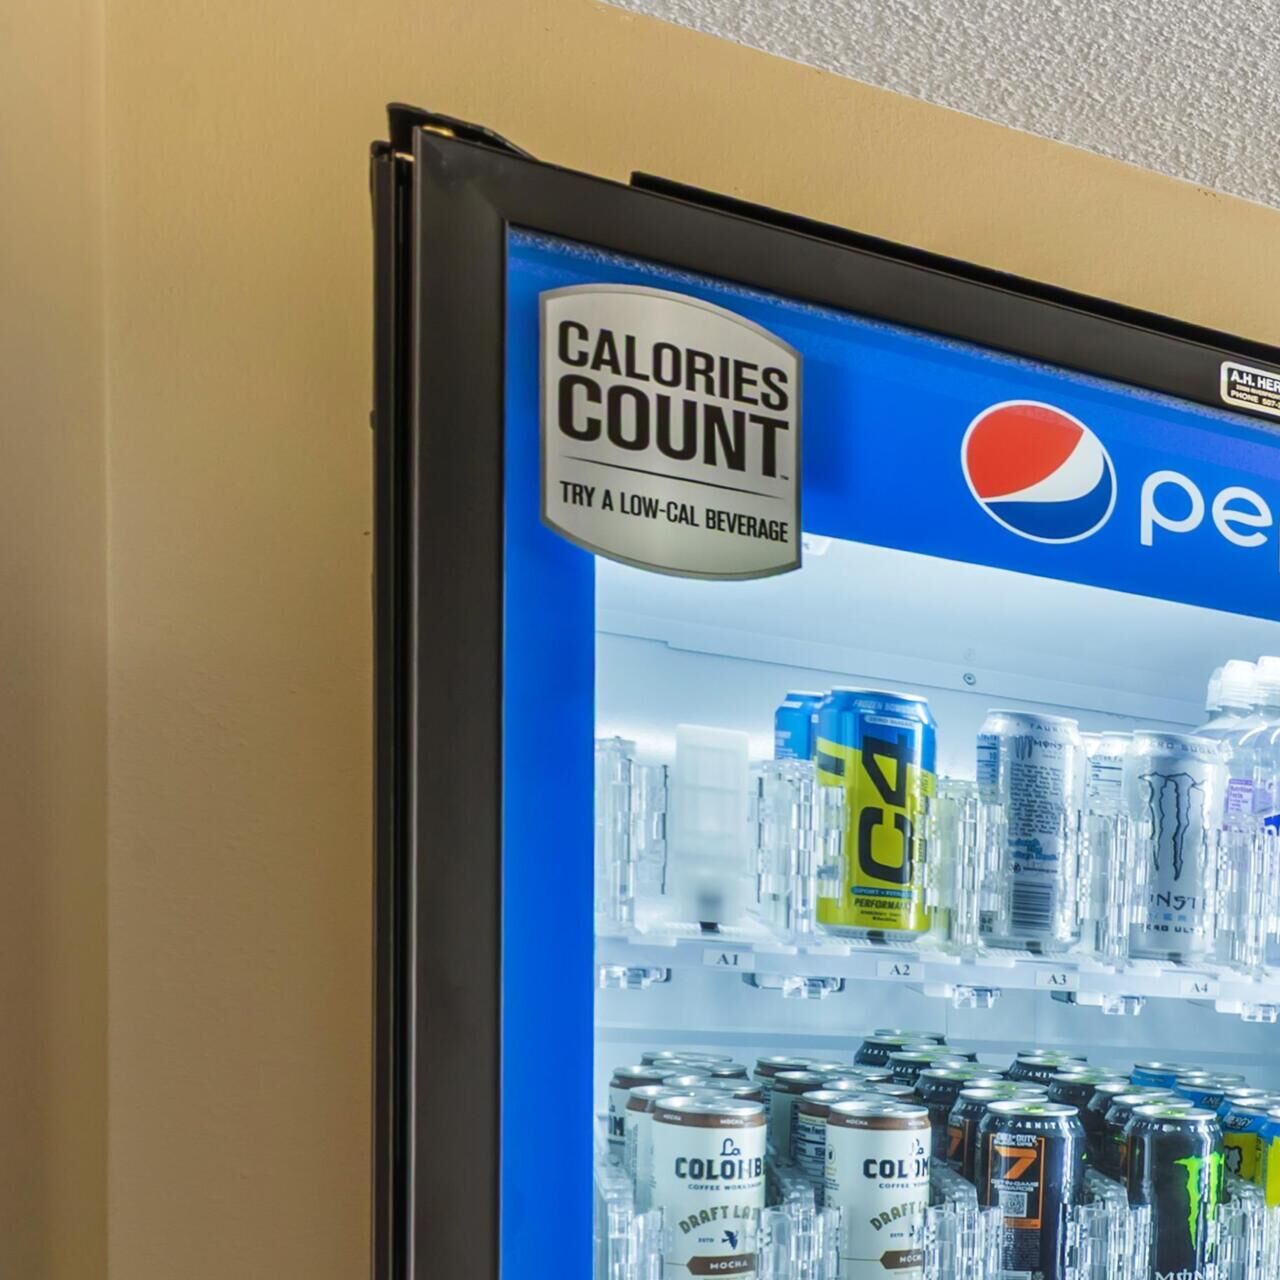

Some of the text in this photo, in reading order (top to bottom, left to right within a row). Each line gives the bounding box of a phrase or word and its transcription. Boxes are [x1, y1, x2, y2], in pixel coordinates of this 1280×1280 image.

[558, 320, 789, 412] CALORIES
[1230, 370, 1255, 387] A.H.
[1230, 389, 1259, 404] PHONE
[558, 374, 789, 479] COUNT
[560, 481, 788, 543] TRY A LOW-CAL BEVERAGE
[716, 953, 739, 966] A1
[889, 963, 911, 976] A2
[1049, 973, 1067, 986] A3
[1191, 983, 1208, 993] A4
[719, 1137, 741, 1156] La
[688, 1183, 720, 1191] COFFEE
[678, 1205, 729, 1235] DRAFT
[709, 1259, 749, 1270] MOCHA
